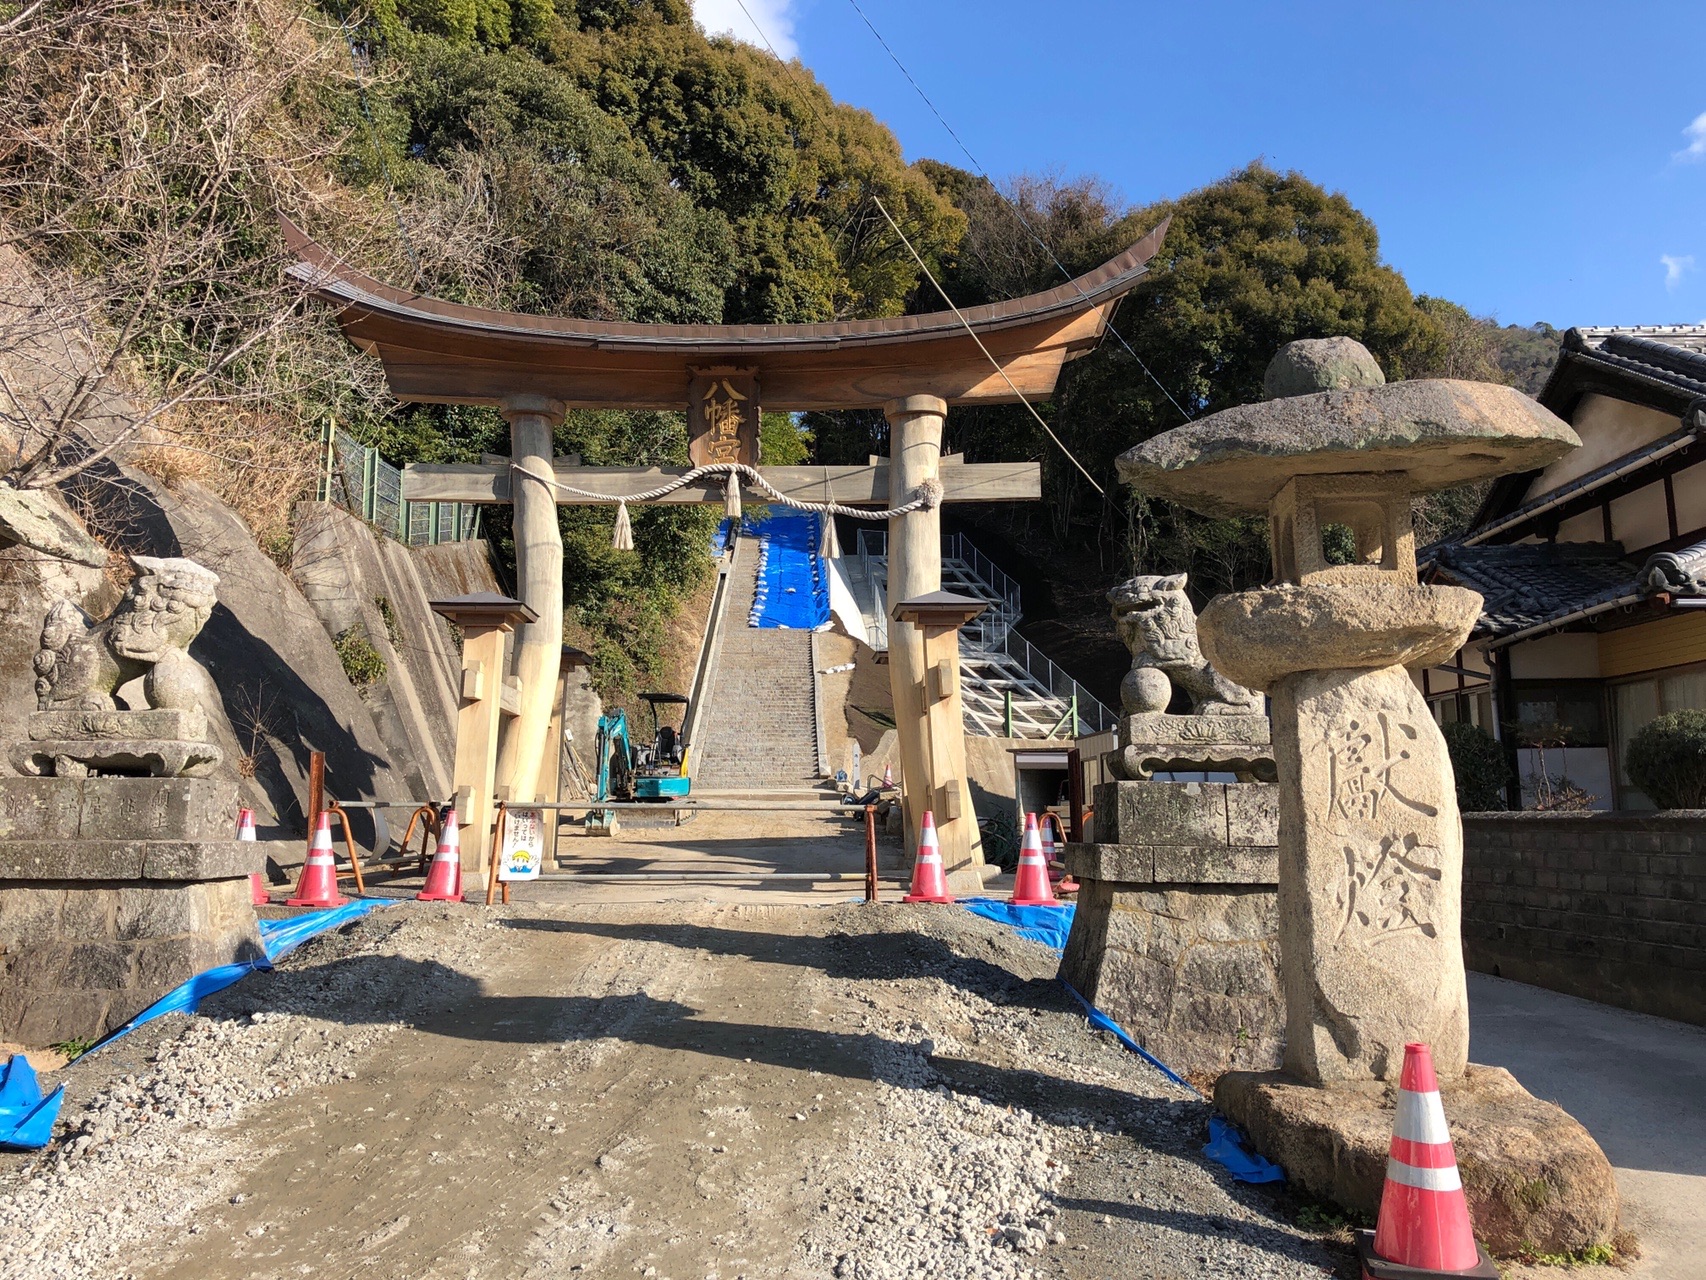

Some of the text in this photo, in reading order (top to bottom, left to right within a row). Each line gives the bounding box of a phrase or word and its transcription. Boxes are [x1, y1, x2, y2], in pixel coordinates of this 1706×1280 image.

[520, 811, 529, 841] はいっては
